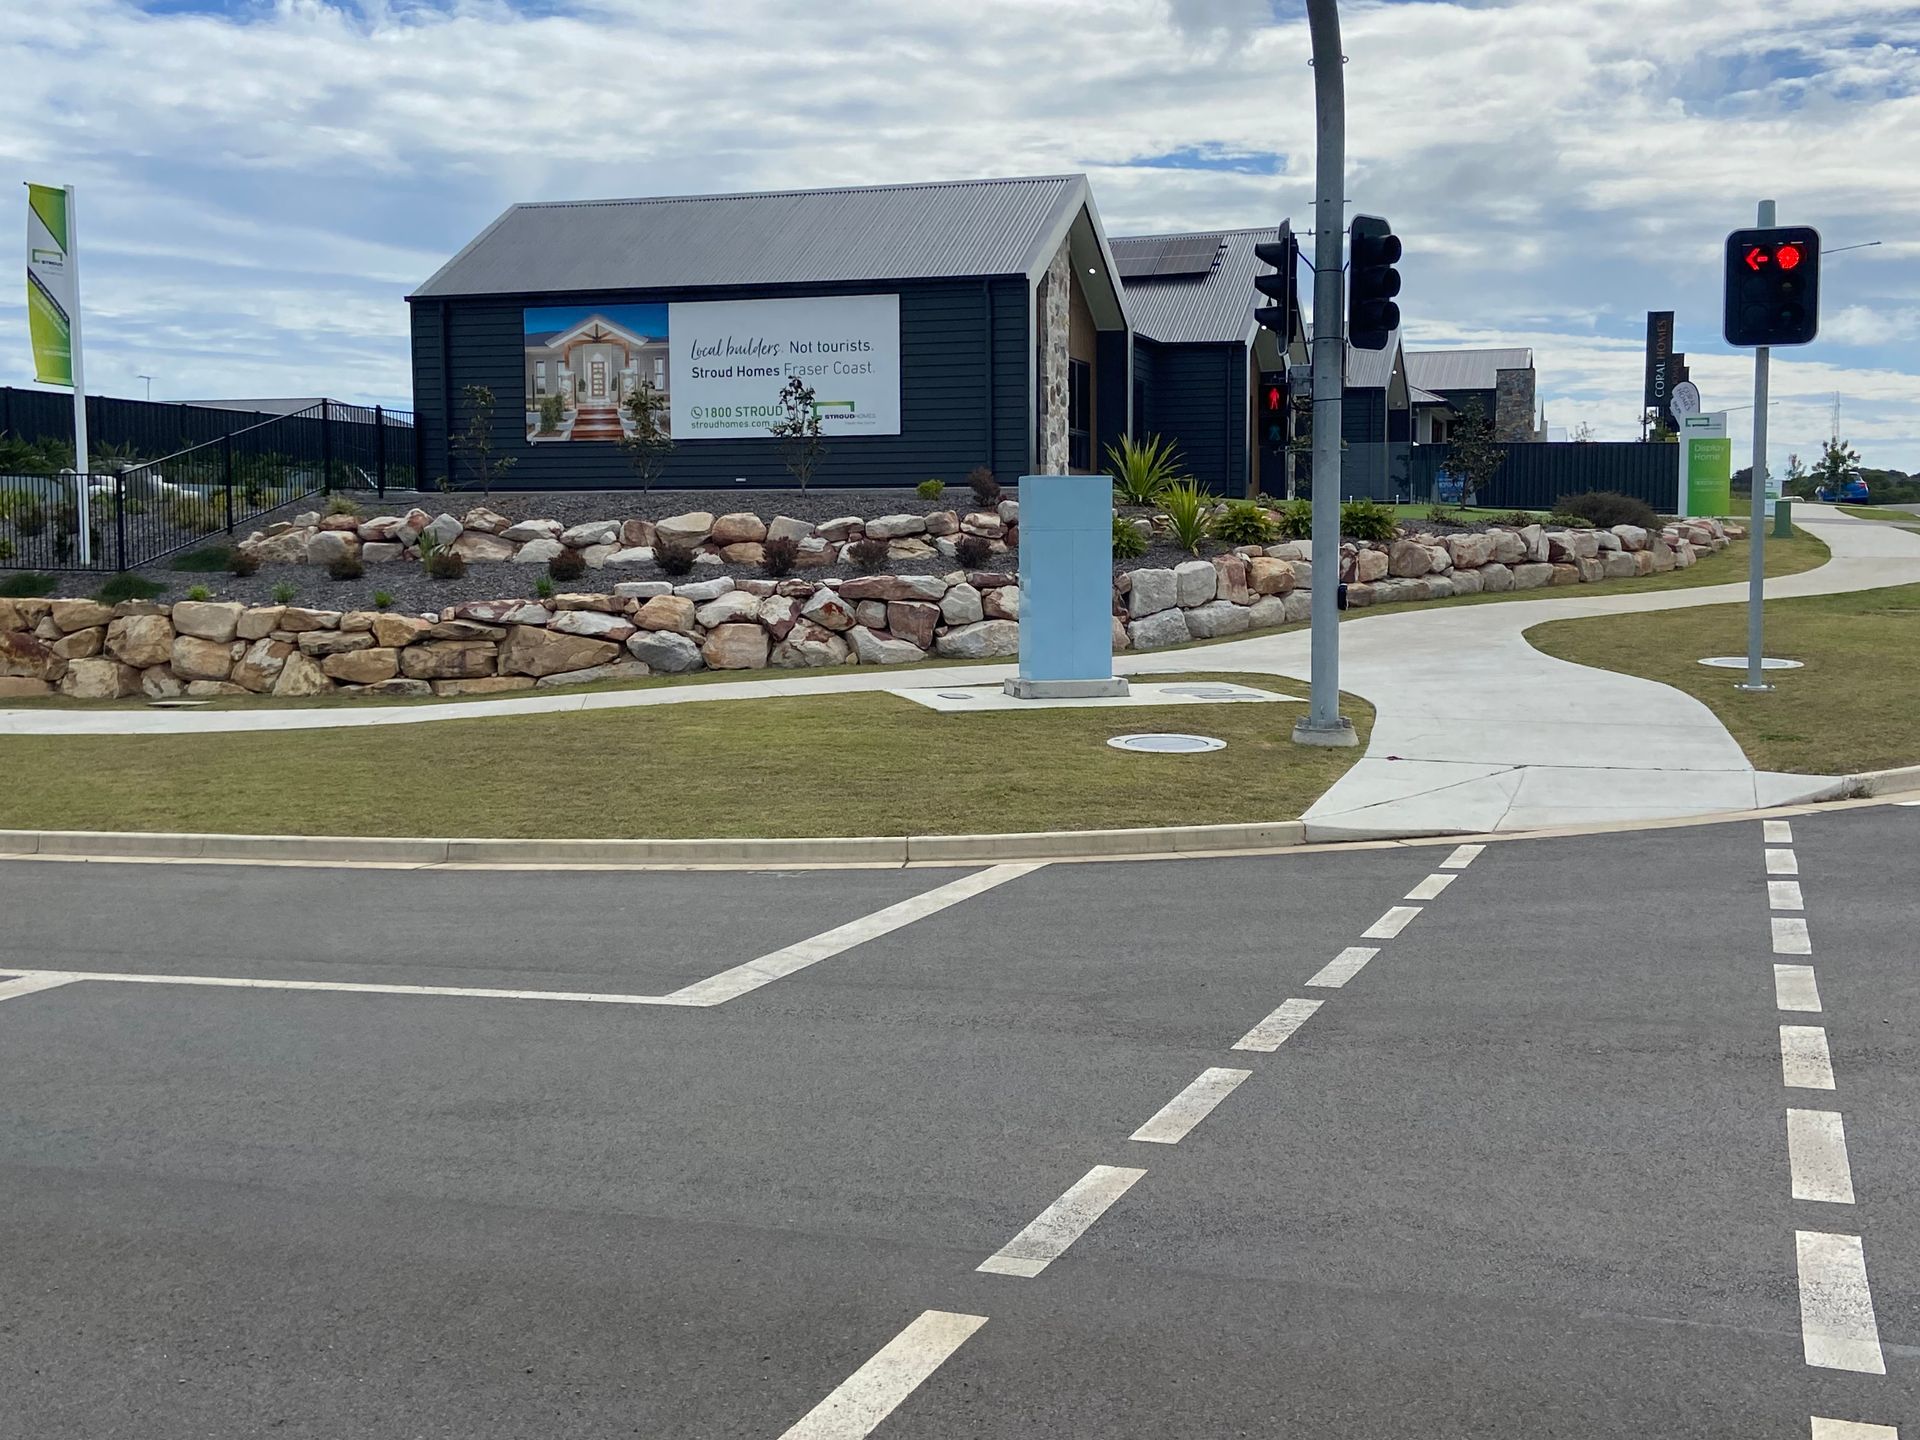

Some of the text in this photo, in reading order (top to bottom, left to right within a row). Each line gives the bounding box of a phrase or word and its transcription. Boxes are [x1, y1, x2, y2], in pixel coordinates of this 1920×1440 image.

[691, 336, 875, 360] Local builders. Not tourists.
[1655, 320, 1667, 397] CORAL HOMES
[692, 361, 876, 378] Stroud Homes Fraser Coast.
[704, 405, 783, 418] 1800 STROUD
[1694, 444, 1725, 454] Display
[1694, 453, 1720, 461] Home
